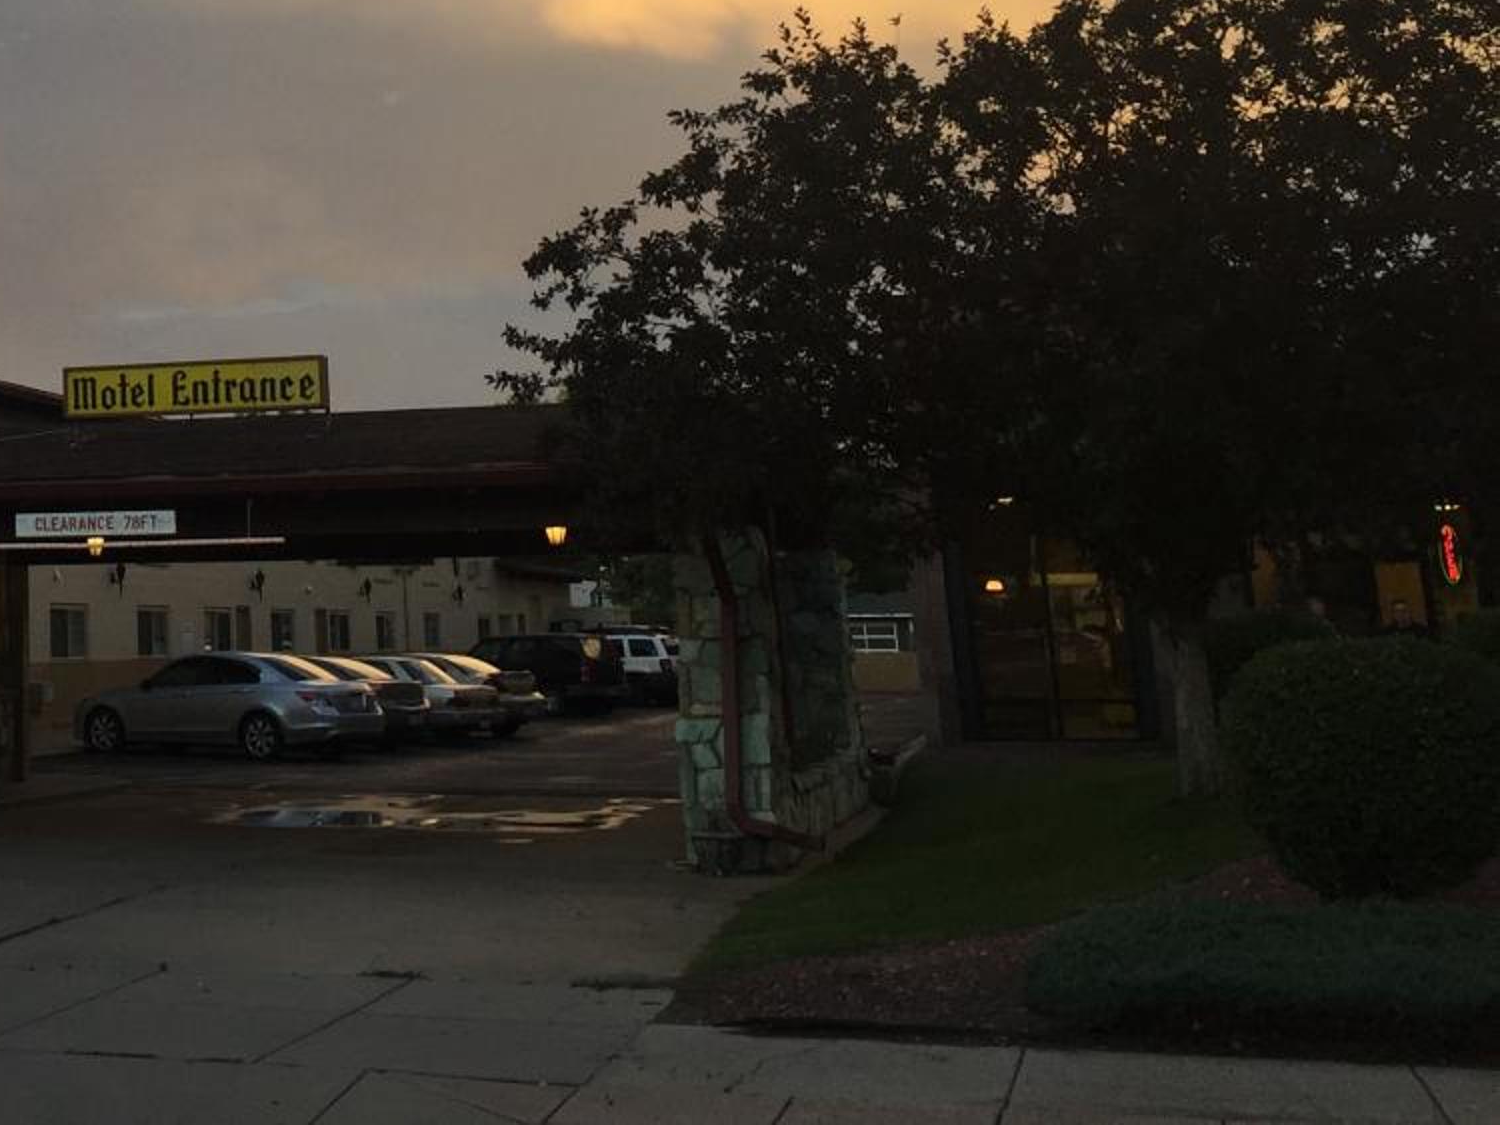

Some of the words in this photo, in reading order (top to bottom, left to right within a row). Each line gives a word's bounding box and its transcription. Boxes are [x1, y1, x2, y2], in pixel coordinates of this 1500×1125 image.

[73, 373, 154, 409] Motel
[172, 370, 315, 406] Entrance
[35, 514, 114, 532] CLEARANCE
